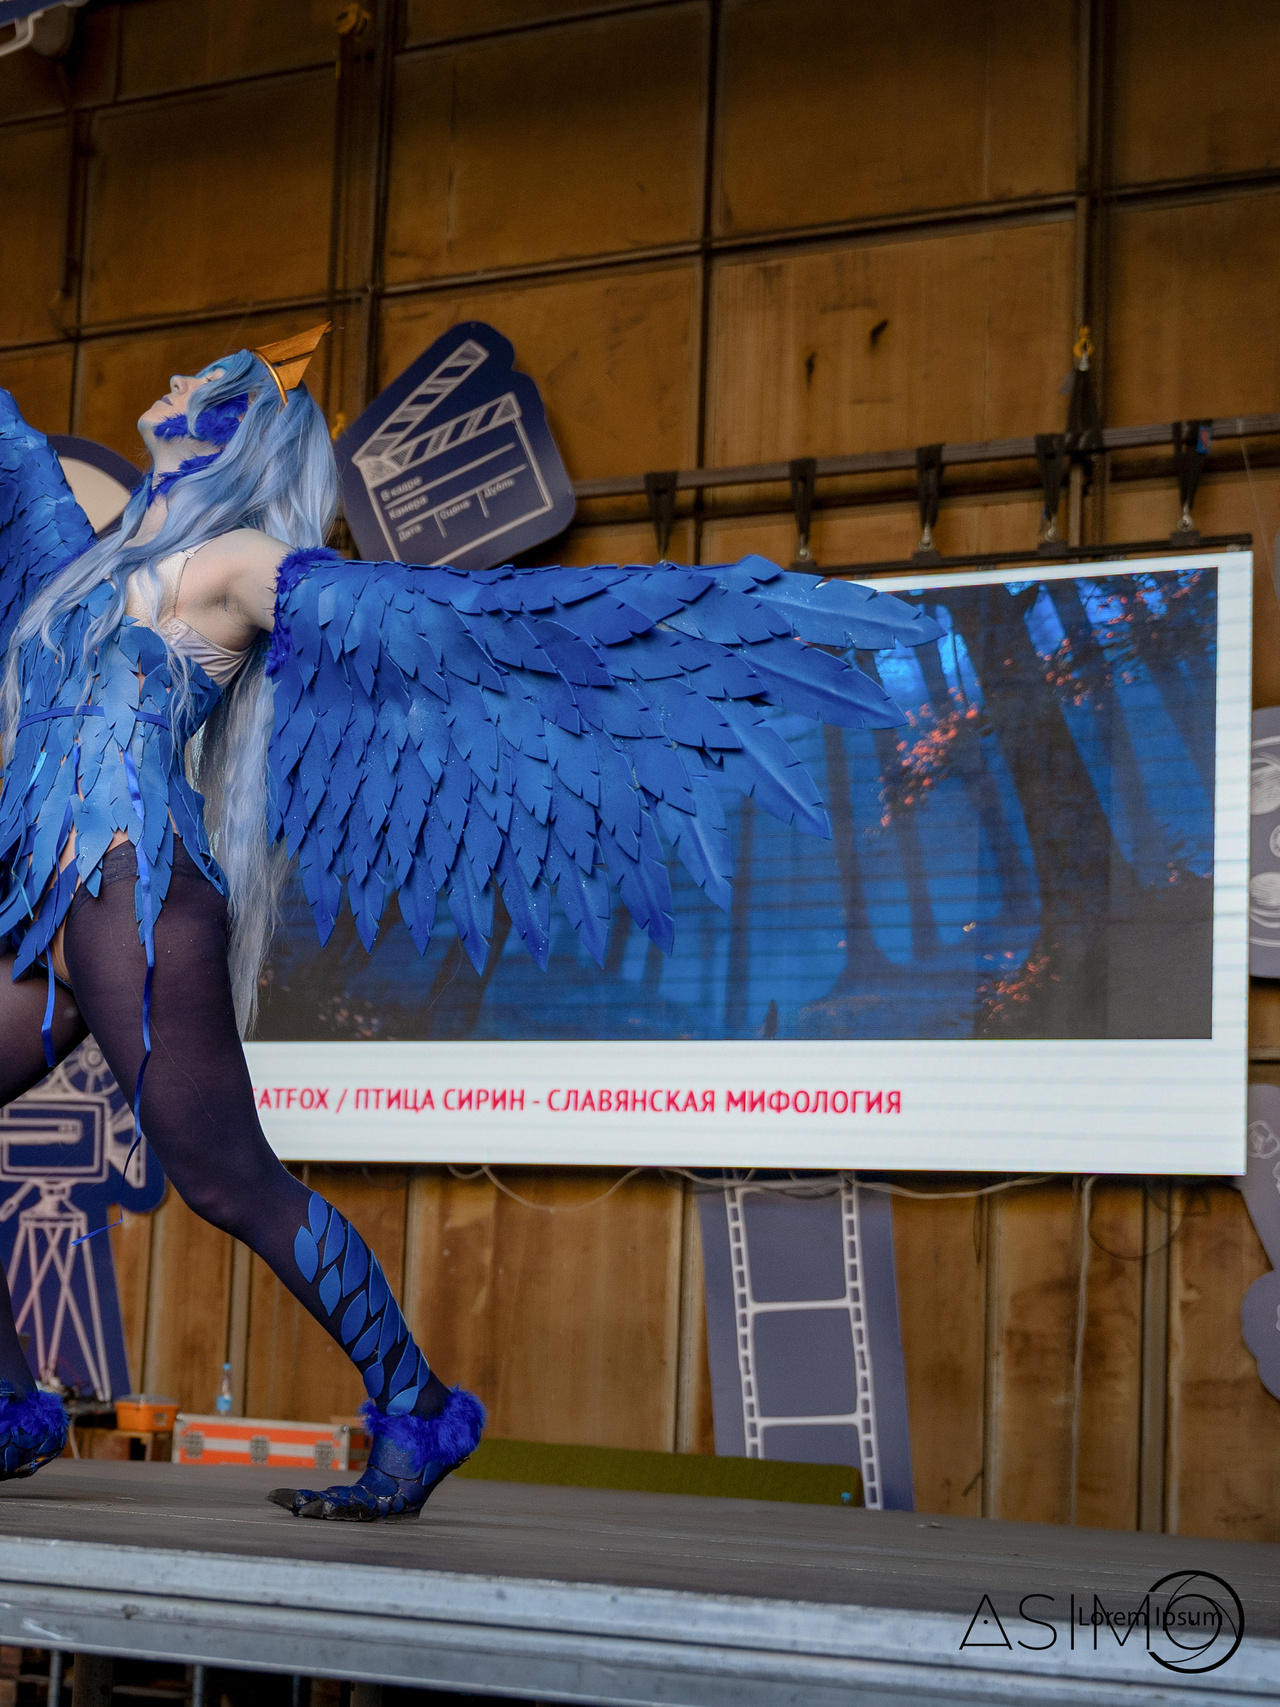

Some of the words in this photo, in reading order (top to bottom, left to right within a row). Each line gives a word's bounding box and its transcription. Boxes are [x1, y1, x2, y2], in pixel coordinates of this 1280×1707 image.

[388, 495, 428, 520] Камера
[252, 1087, 329, 1110] ATFOX
[354, 1088, 435, 1113] ПТИЦА
[443, 1088, 525, 1111] СИРИН
[547, 1088, 716, 1112] СЛАВЯНСКАЯ
[724, 1089, 902, 1114] МИФОЛОГИЯ
